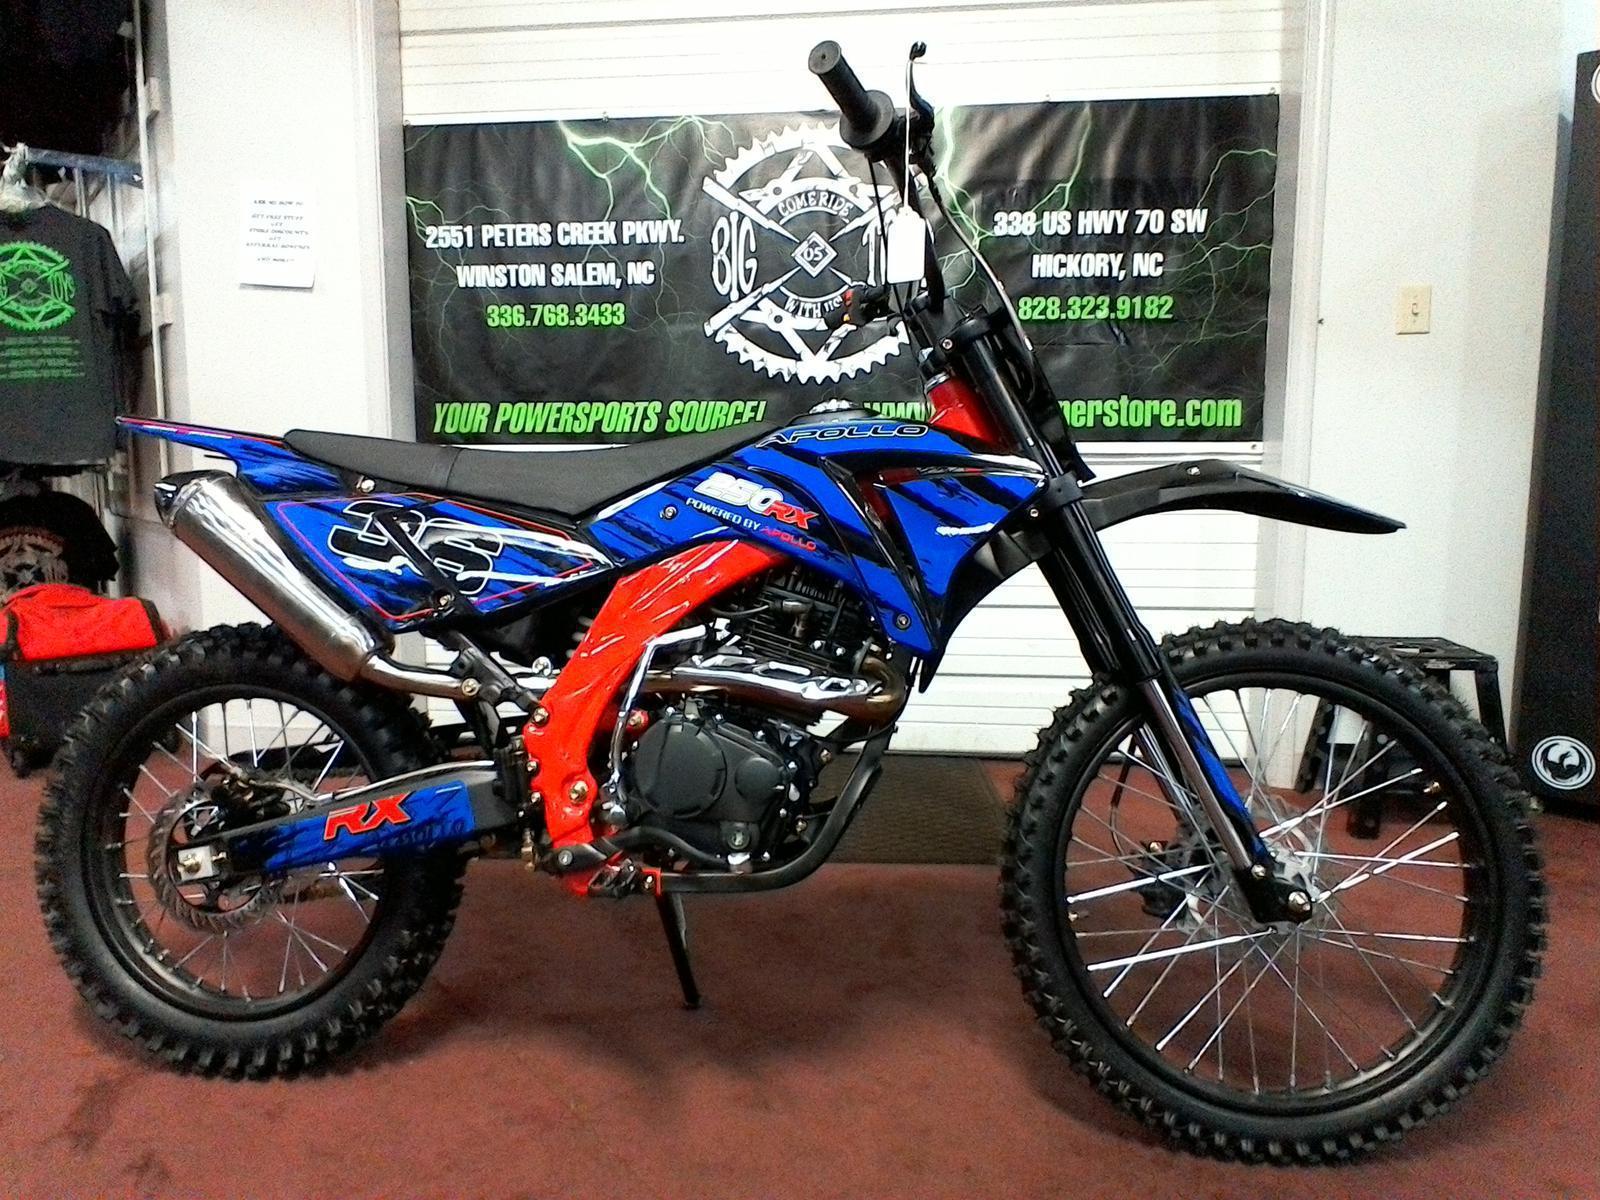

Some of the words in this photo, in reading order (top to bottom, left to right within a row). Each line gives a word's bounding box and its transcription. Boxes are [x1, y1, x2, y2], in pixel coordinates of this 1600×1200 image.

[778, 191, 818, 217] COME
[819, 191, 854, 217] RIDE
[426, 225, 473, 248] 2551
[482, 223, 552, 247] PETERS
[557, 221, 617, 246] CREEK
[622, 219, 685, 244] PKWY.
[993, 211, 1037, 236] 338
[1042, 210, 1072, 235] US
[1077, 209, 1129, 234] HWY
[1134, 209, 1165, 234] 70
[1170, 208, 1209, 233] SW
[711, 210, 758, 301] BIG
[1031, 253, 1126, 281] HICKORY,
[1132, 252, 1165, 277] NC
[456, 264, 545, 288] WINSTON
[551, 262, 622, 289] SALEM,
[627, 261, 655, 285] NC
[486, 303, 626, 328] 336.768.3433
[784, 296, 822, 318] WITH
[1018, 295, 1174, 320] 828.323.9182
[433, 402, 490, 434] YOUR
[493, 401, 661, 434] POWERSPORTS
[755, 424, 929, 448] APOLLO
[686, 497, 742, 524] POWERED
[743, 518, 761, 530] BY
[760, 526, 817, 551] APOLLO
[324, 791, 414, 841] RX
